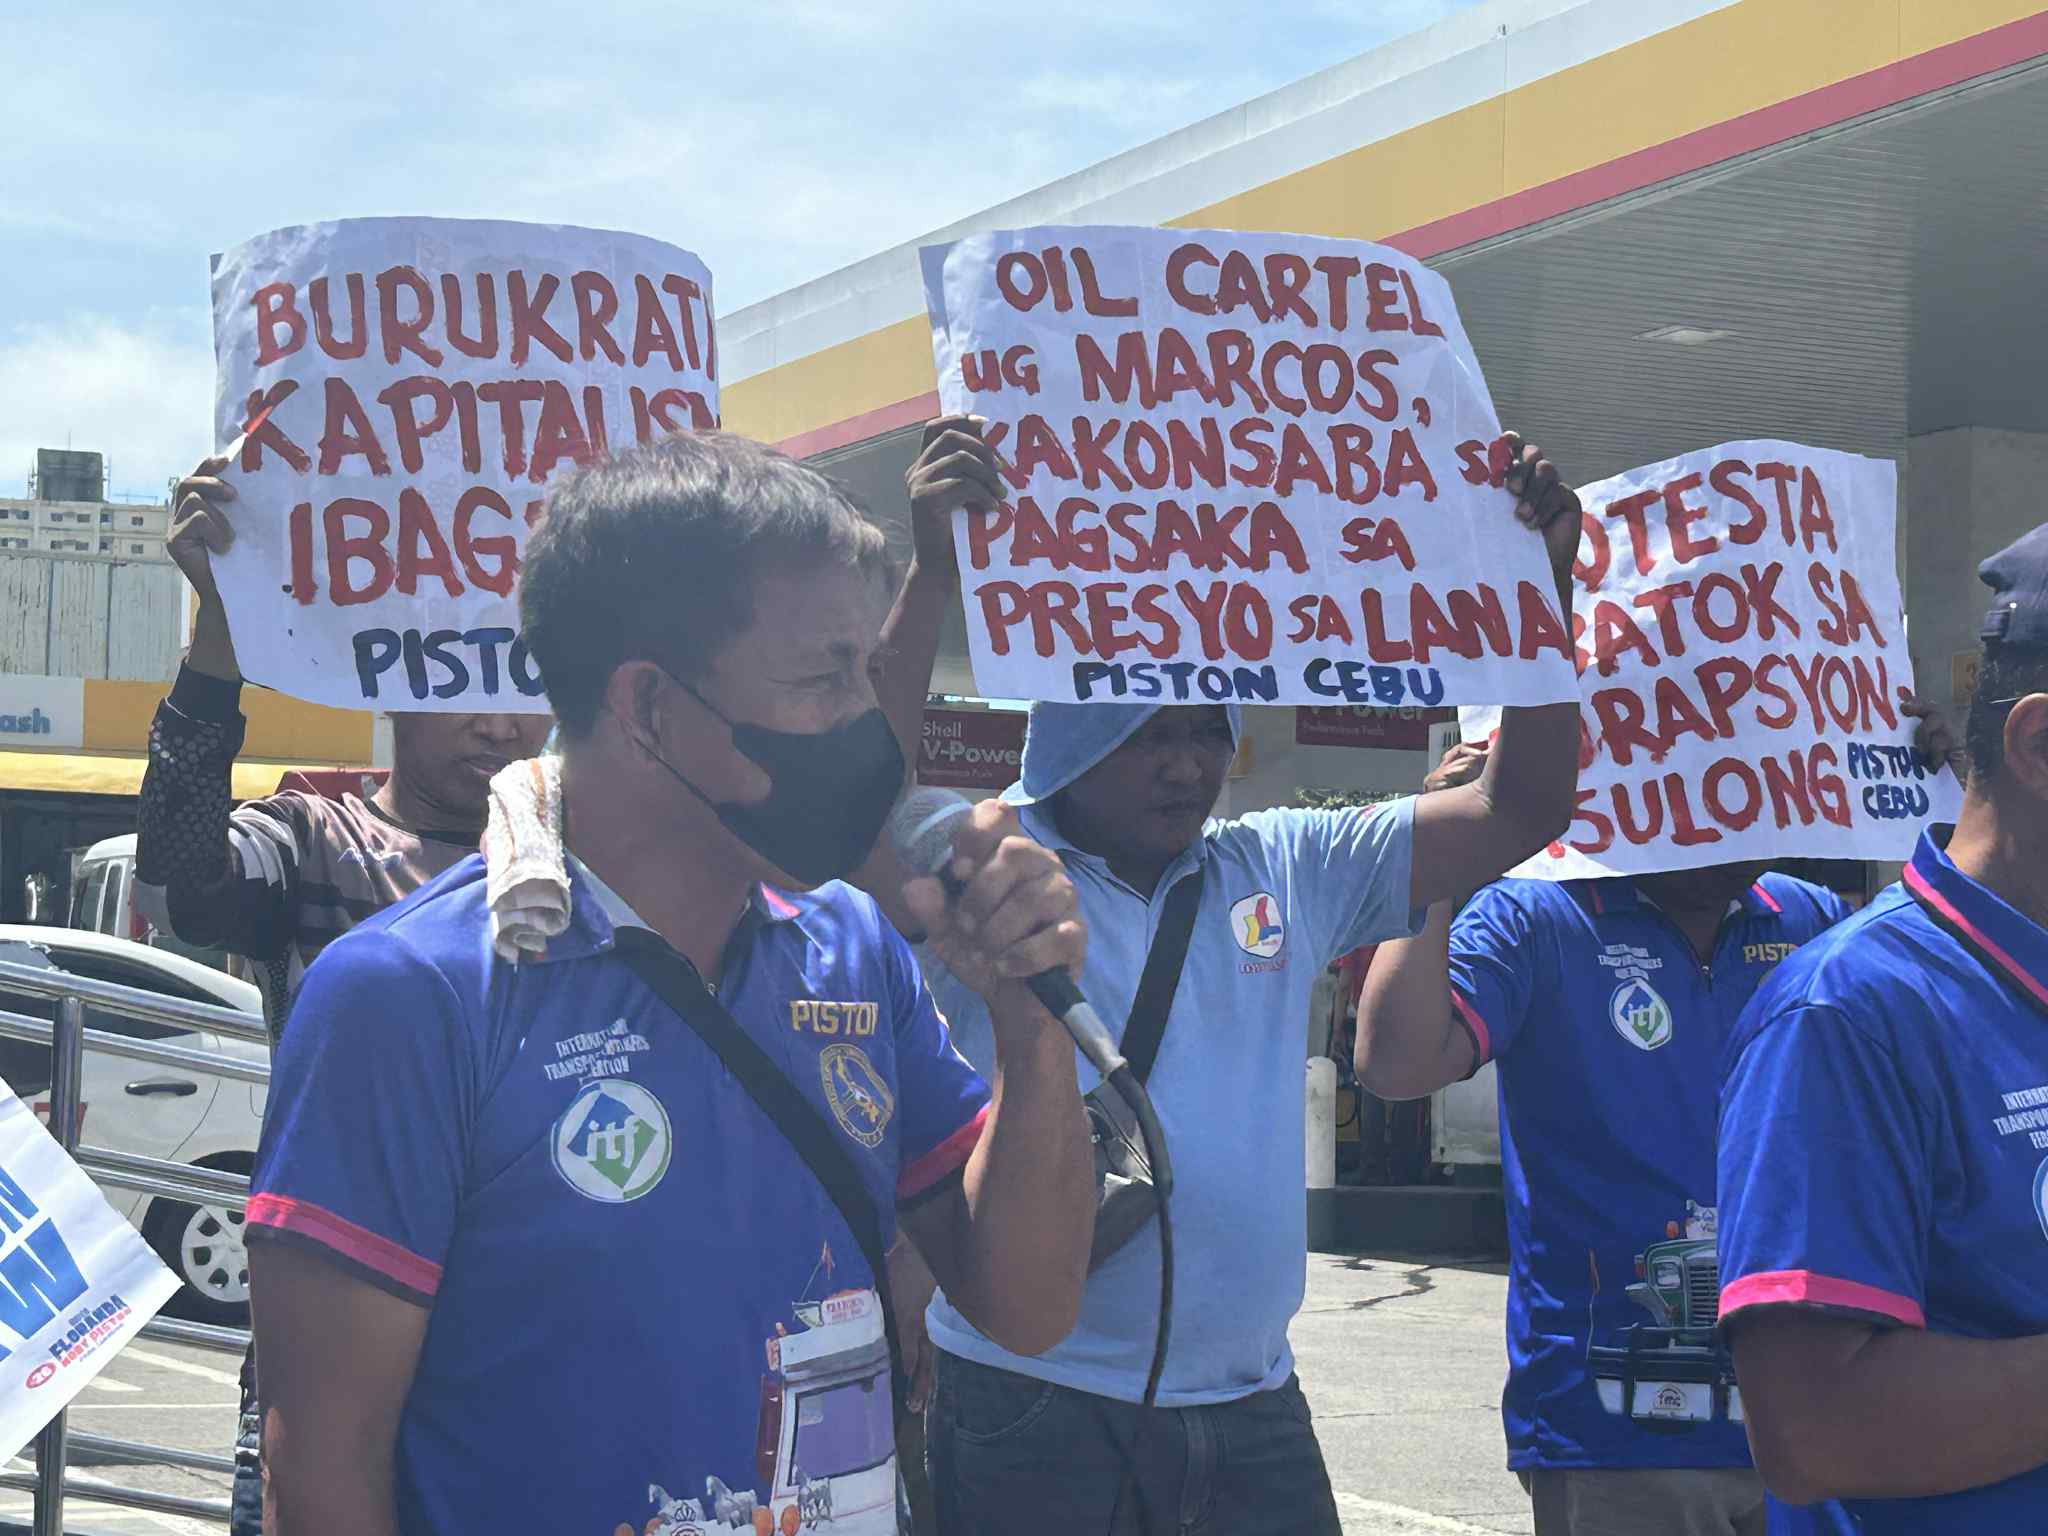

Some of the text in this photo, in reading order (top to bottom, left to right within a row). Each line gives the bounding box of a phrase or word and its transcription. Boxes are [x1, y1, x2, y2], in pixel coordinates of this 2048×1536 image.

[996, 244, 1444, 337] OIL CARTEL
[961, 345, 1040, 395] UG
[289, 487, 547, 606] IBAG
[966, 496, 1416, 573] PAGSAKA SA
[1572, 460, 1838, 593] OTESTA
[973, 580, 1572, 662] PRESYO SA LANA
[1808, 562, 1887, 648] SA
[353, 628, 547, 698] PISTO
[1073, 659, 1444, 705] PISTON CEBU
[922, 720, 961, 736] Shell
[922, 739, 1018, 765] V-Powe
[1562, 742, 1852, 858] SULONG
[1862, 784, 1929, 819] CEBU
